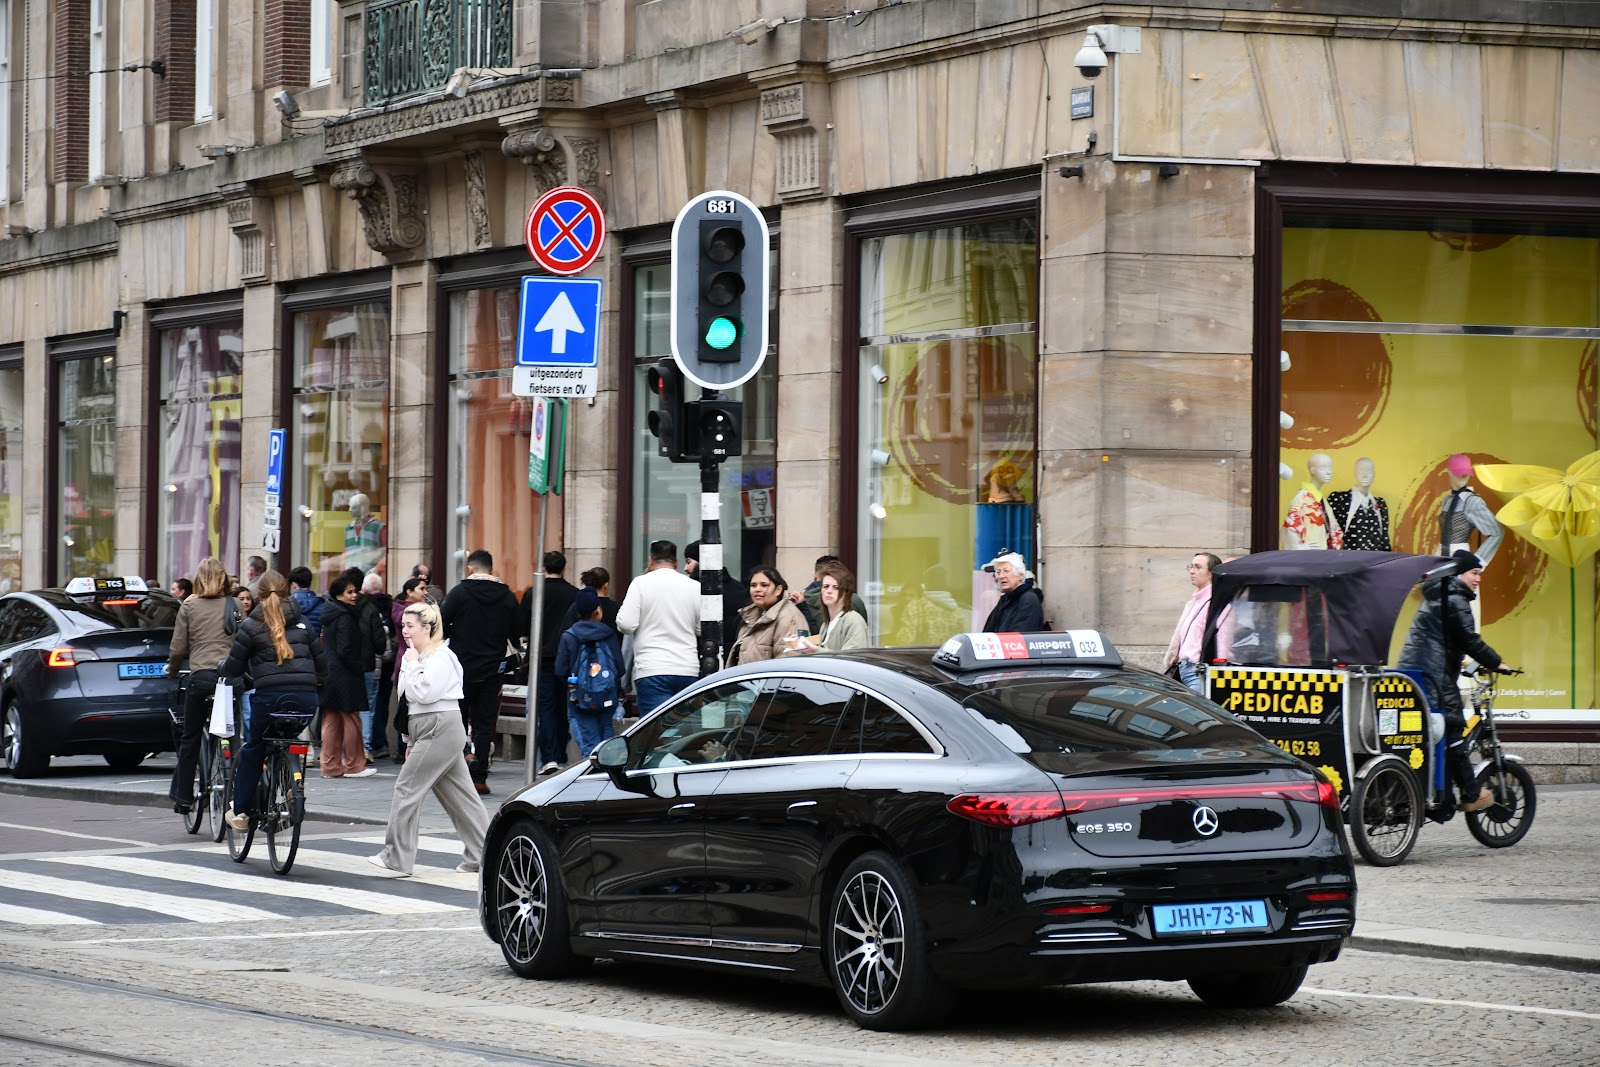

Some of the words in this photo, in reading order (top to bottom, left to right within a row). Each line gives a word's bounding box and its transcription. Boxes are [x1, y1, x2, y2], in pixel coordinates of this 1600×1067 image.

[707, 200, 735, 213] 681
[530, 367, 583, 380] uitgezonderd
[529, 383, 560, 394] fietsers
[563, 386, 573, 394] en
[575, 384, 587, 395] OV
[270, 435, 280, 467] P
[106, 580, 123, 588] TCS
[975, 643, 1000, 651] TAXI
[1004, 642, 1025, 651] TCA
[1029, 641, 1071, 650] AIRPORT
[1079, 641, 1098, 653] 032
[1500, 689, 1517, 697] Zadig
[1524, 688, 1545, 696] Voltaire
[1230, 692, 1324, 714] PEDICAB
[1376, 698, 1415, 708] PEDICAB
[1288, 717, 1321, 725] TRANSFERS
[1292, 740, 1305, 755] 62
[1307, 741, 1320, 756] 58
[1077, 824, 1103, 833] EQS
[1107, 822, 1132, 832] 350
[1169, 905, 1254, 928] JHH-73-N
